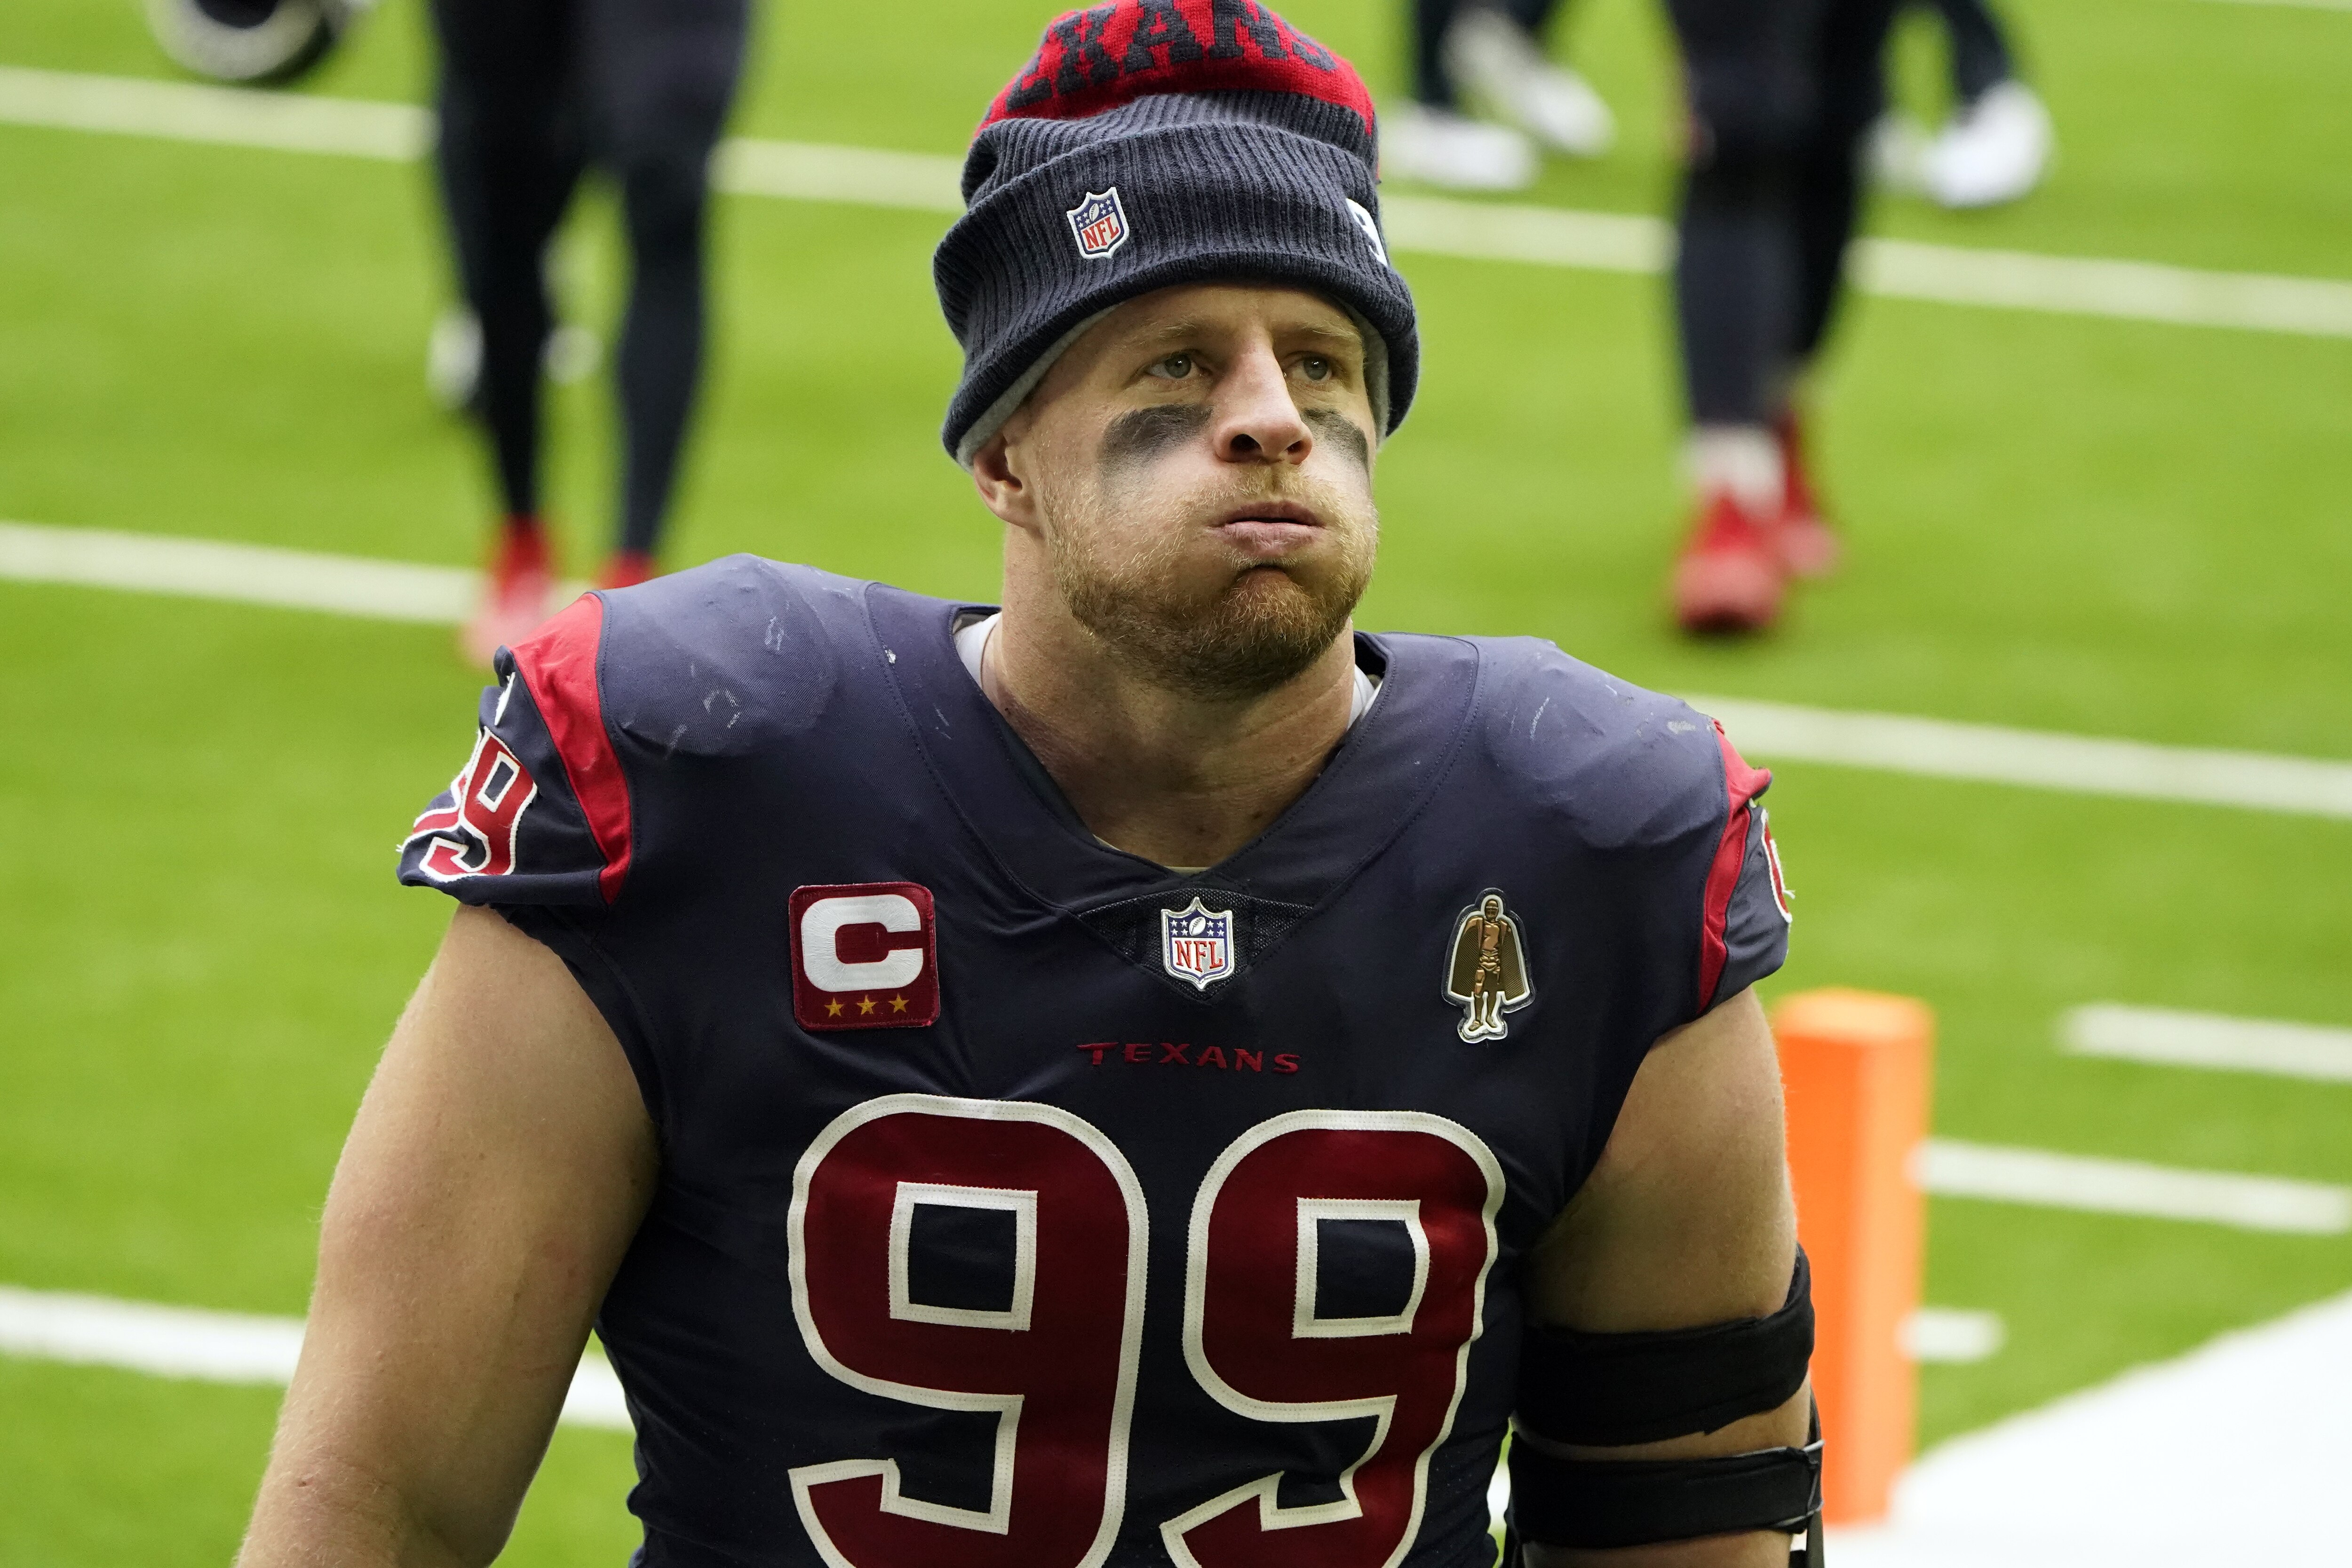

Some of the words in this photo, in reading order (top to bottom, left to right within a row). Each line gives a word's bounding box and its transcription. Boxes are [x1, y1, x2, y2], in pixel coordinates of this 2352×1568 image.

[1082, 216, 1120, 249] NFL
[801, 894, 923, 992] C
[1175, 940, 1224, 972] NFL
[1076, 1042, 1301, 1074] TEXANS
[787, 1093, 1506, 1568] 99
